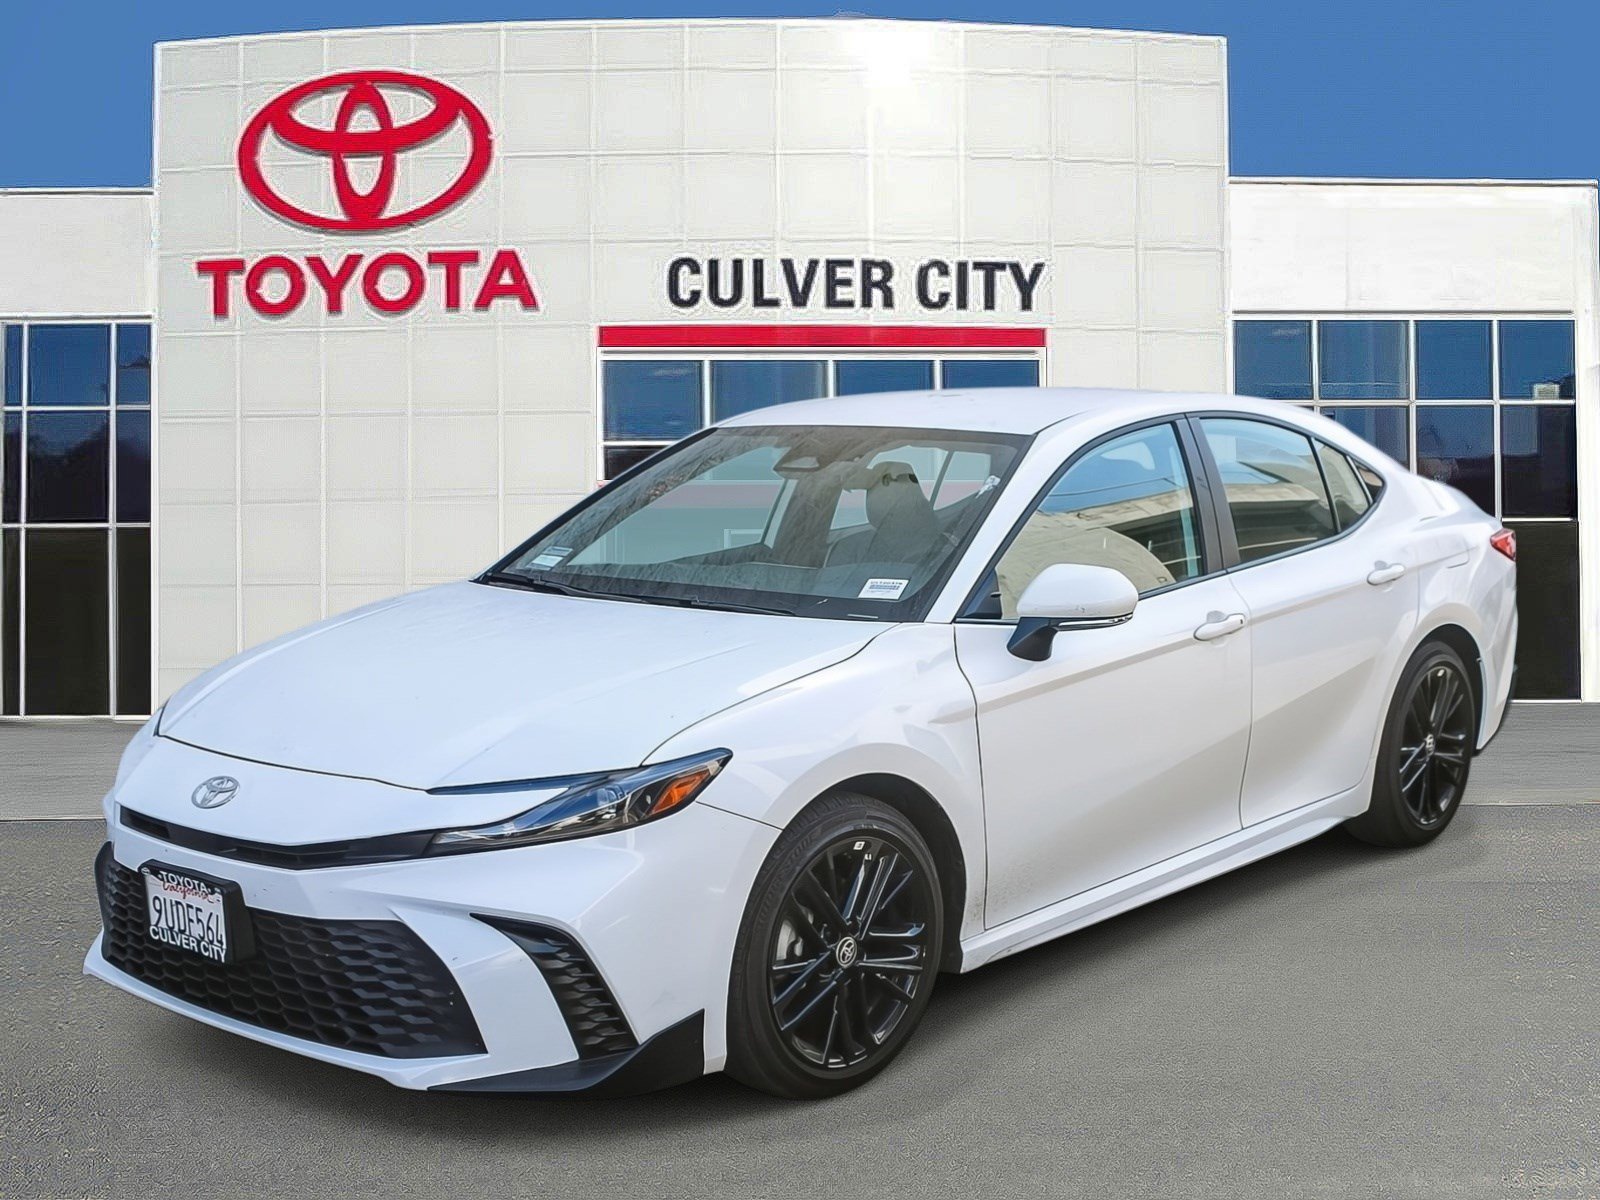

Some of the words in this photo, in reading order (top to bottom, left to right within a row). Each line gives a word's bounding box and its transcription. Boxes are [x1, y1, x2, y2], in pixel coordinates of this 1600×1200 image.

[197, 249, 538, 317] TOYOTA
[668, 258, 893, 309] CULVER
[917, 260, 1045, 311] CITY
[160, 870, 208, 893] TOYOTA
[149, 925, 199, 953] CULVER
[200, 940, 226, 963] CITY
[152, 895, 224, 947] 9UDF564
